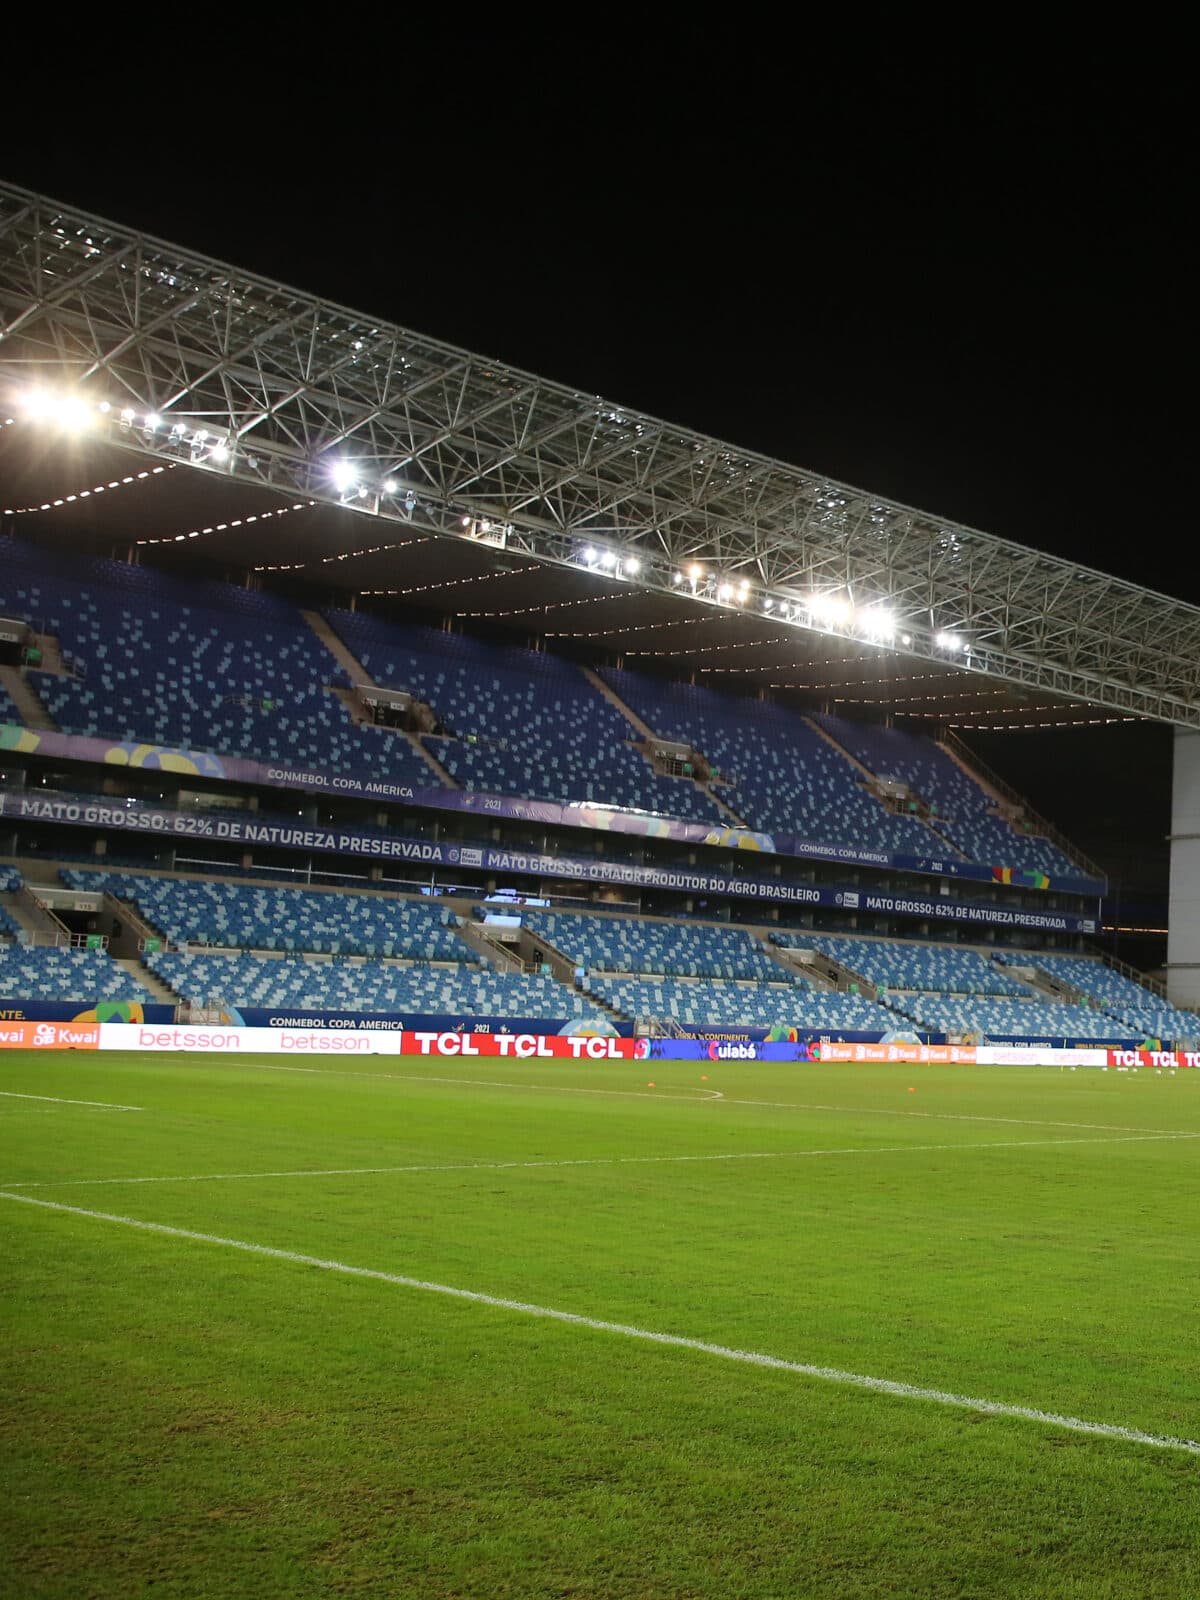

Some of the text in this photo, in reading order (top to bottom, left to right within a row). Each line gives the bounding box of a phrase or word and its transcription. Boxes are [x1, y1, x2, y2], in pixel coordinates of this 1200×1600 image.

[267, 768, 414, 799] CONMEBOL COPA AMERICA
[484, 799, 501, 810] 2021
[20, 799, 442, 862] MATO GROSSO: 62% DE NATUREZA PRESERVADA
[800, 843, 889, 863] CONMEBOL COPA AMERICA
[488, 853, 527, 870] MATO
[530, 856, 587, 878] GROSSO:
[601, 867, 642, 883] MAIOR
[644, 872, 707, 890] PRODUTOR
[709, 879, 726, 892] DO
[727, 881, 757, 896] AGRO
[759, 884, 821, 902] BRASILEIRO
[866, 897, 894, 910] MATO
[895, 899, 936, 916] GROSSO:
[935, 903, 955, 917] 62%
[955, 905, 969, 918] DE
[968, 909, 1014, 924] NATUREZA
[1014, 914, 1067, 930] PRESERVADA
[269, 1017, 404, 1031] CONMEBOL COPA AMERICA
[474, 1023, 490, 1033] 2021
[58, 1029, 98, 1044] Kwai
[139, 1028, 370, 1050] betsson betsson
[414, 1032, 623, 1059] TCL TCL TCL
[708, 1040, 757, 1061] Cuiabá
[1113, 1051, 1144, 1066] TCL
[1150, 1052, 1178, 1066] TCL
